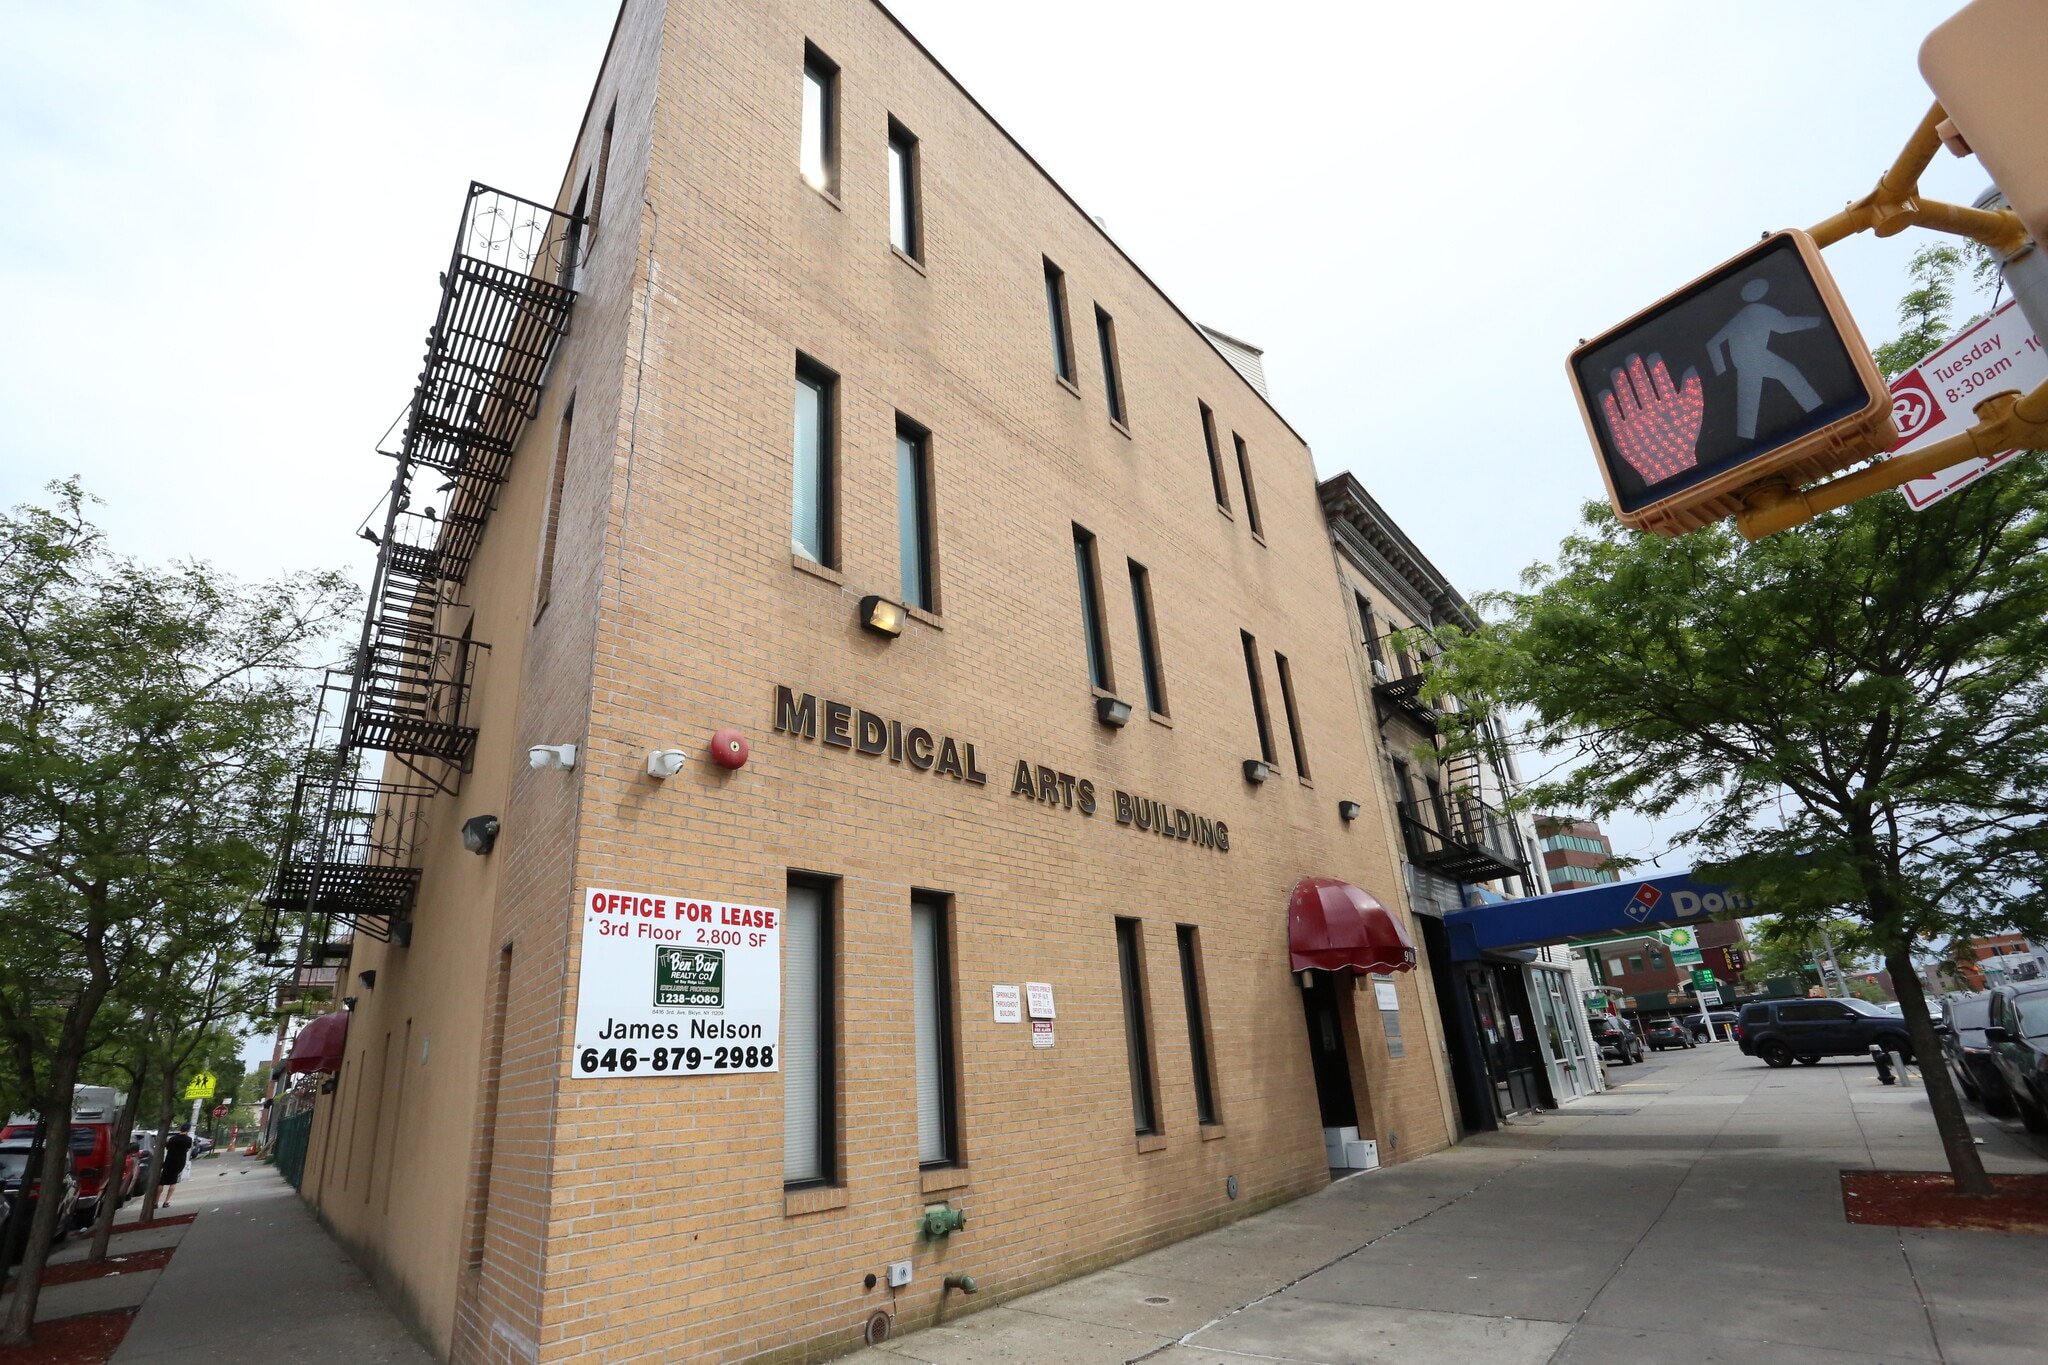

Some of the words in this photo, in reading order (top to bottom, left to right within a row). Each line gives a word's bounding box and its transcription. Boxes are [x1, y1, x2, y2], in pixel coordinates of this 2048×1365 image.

[1933, 335, 2002, 383] Tuesday
[1946, 357, 2012, 403] 8:30am
[774, 684, 988, 785] MEDICAL
[1012, 759, 1098, 815] ARTS
[1113, 789, 1230, 852] BUILDING
[591, 892, 666, 919] OFFICE
[675, 901, 713, 923] FOR
[721, 906, 775, 929] LEASE
[599, 919, 629, 937] 3rd
[638, 922, 682, 941] Floor
[696, 927, 742, 946] 2,800
[748, 933, 767, 948] SF
[670, 952, 692, 971] Ben
[695, 953, 718, 982] Bay
[671, 972, 697, 980] REALTY
[665, 993, 719, 1005] 238-6080
[599, 1017, 679, 1040] James
[690, 1018, 762, 1039] Nelson
[580, 1045, 774, 1073] 646-879-2988
